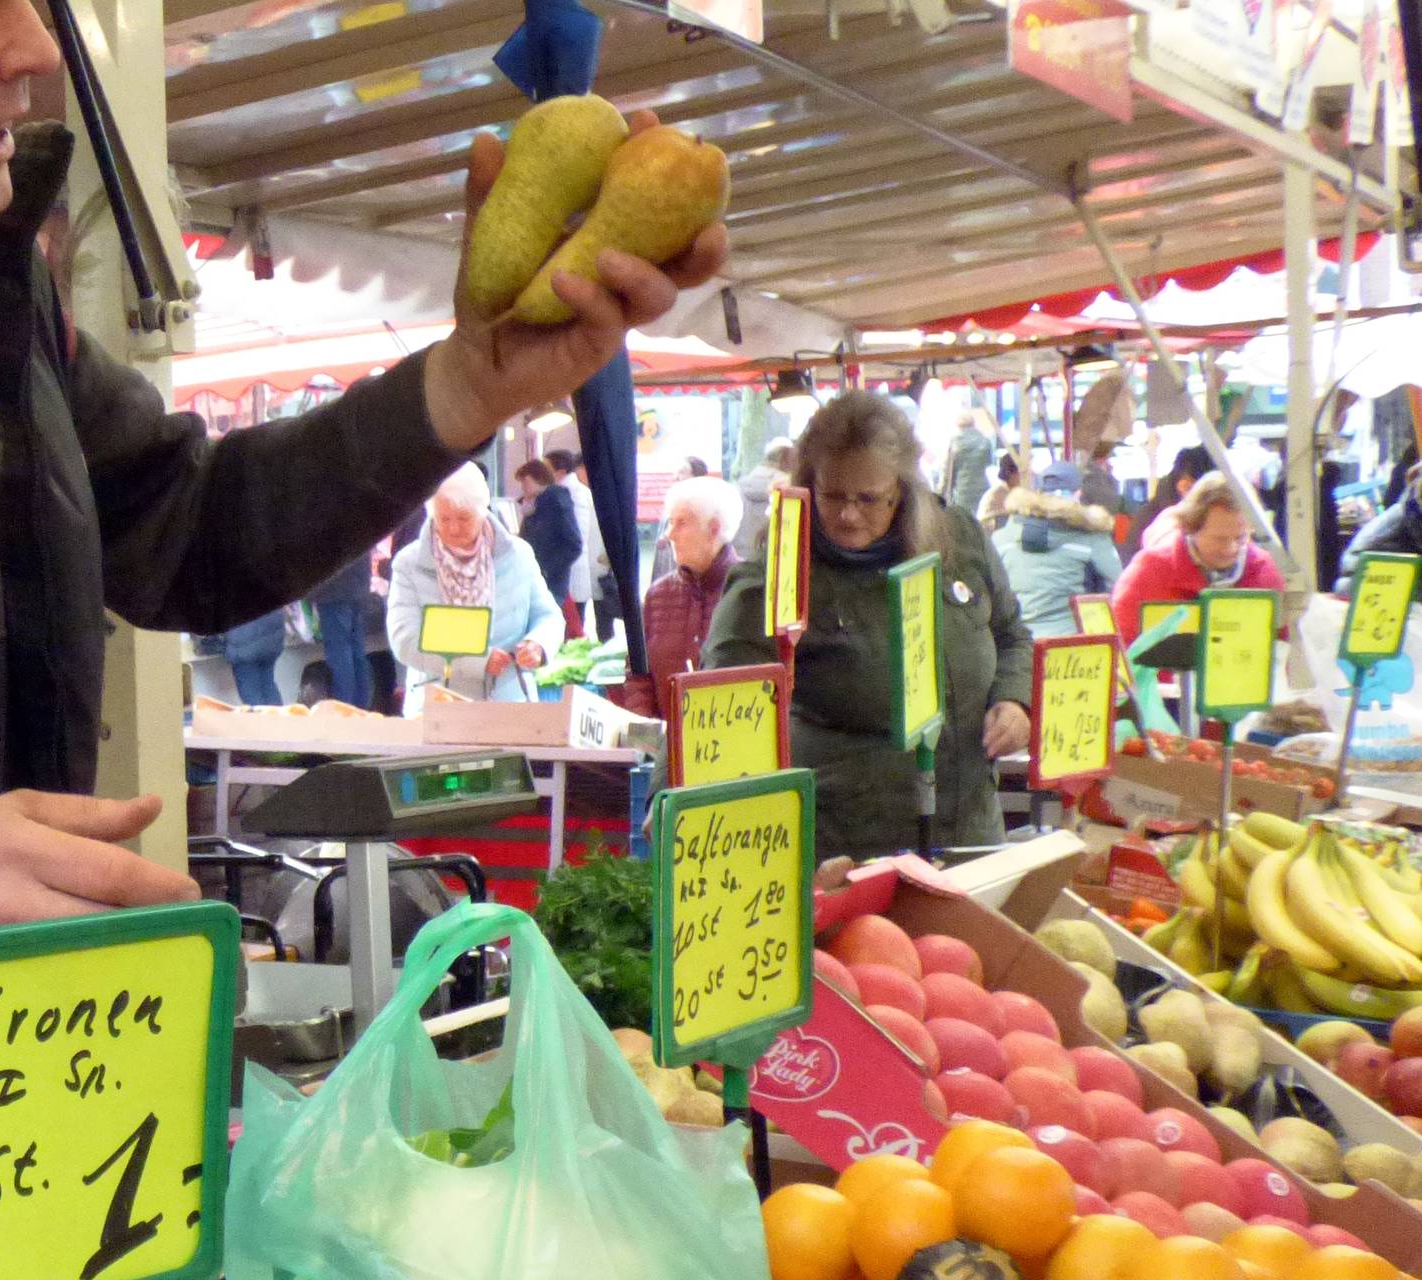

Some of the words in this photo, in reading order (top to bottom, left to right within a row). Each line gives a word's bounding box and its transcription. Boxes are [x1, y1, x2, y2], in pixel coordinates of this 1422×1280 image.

[579, 713, 604, 745] UNO
[674, 812, 790, 873] Saftorangen
[764, 1038, 820, 1069] Pink
[762, 1056, 816, 1093] Lady
